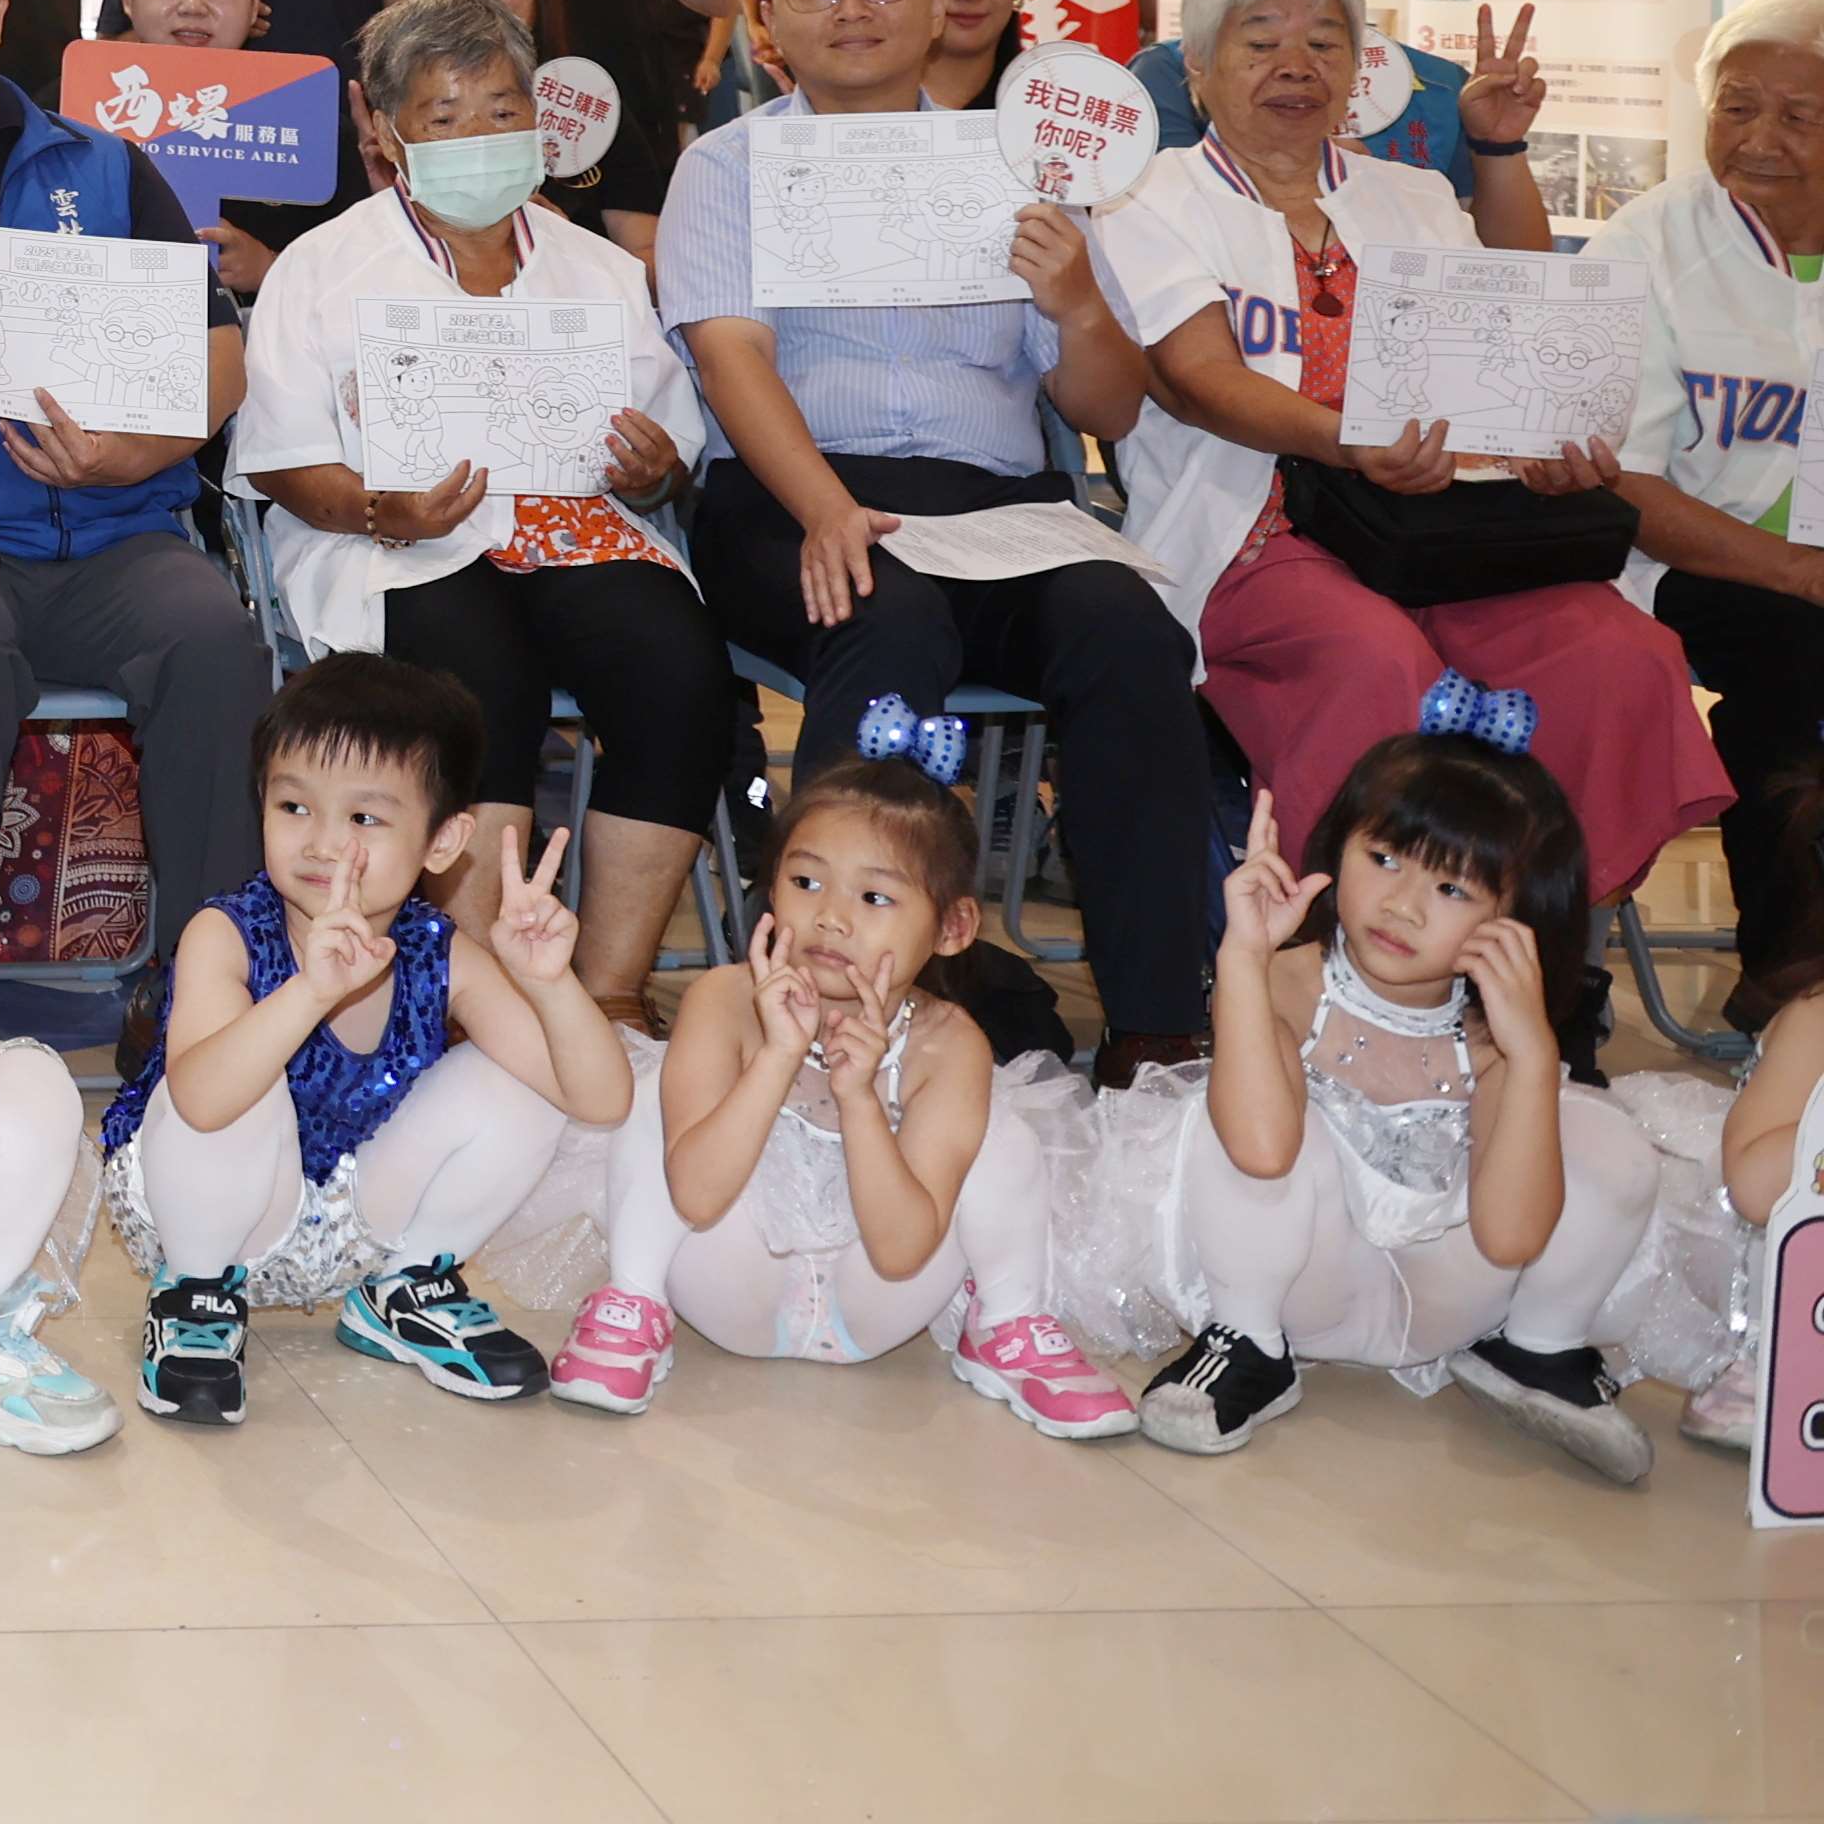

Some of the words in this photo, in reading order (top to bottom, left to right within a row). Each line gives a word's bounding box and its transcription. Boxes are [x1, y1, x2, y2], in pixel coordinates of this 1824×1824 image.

[95, 63, 236, 141] 西螺
[235, 123, 300, 147] 服務區
[535, 75, 614, 126] 我已購票
[1022, 76, 1143, 138] 我已購票
[165, 144, 247, 161] SERVICE
[250, 151, 300, 166] AREA
